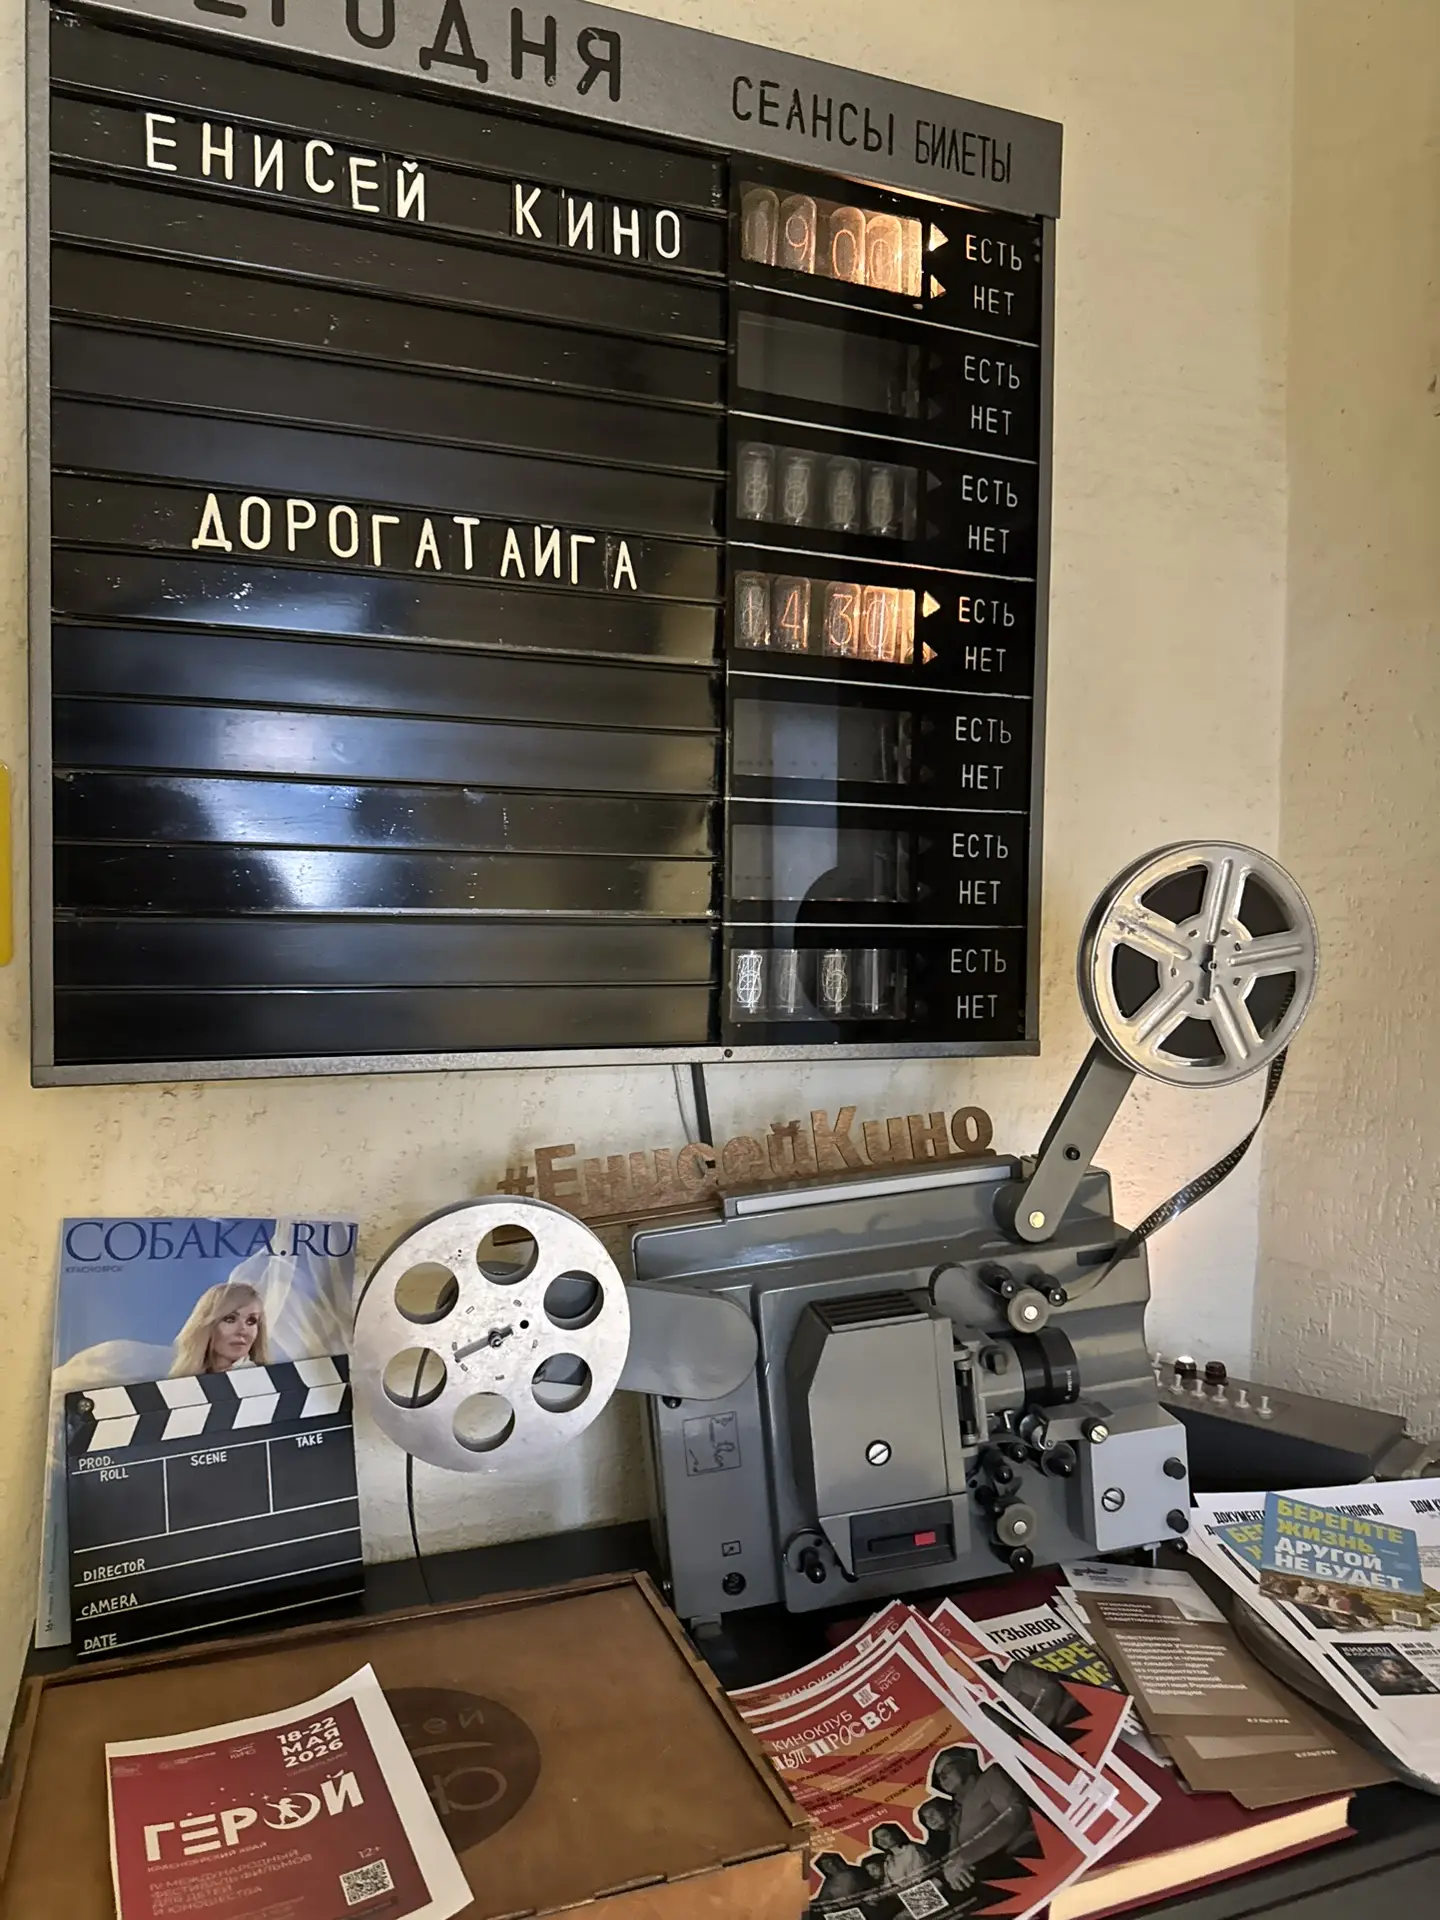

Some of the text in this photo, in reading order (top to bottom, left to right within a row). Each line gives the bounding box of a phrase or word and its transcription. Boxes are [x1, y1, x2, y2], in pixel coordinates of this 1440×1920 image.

[194, 0, 622, 102] ОДНЯ
[732, 75, 1012, 184] СЕАНСЫ БИЛЕТЫ
[145, 112, 681, 259] ЕНИСЕЙ КИНО
[966, 234, 1021, 270] ЕСТЬ
[974, 285, 1014, 315] НЕТ
[965, 356, 1019, 388] ЕСТЬ
[972, 405, 1011, 434] НЕТ
[962, 475, 1017, 507] ЕСТЬ
[969, 525, 1009, 553] НЕТ
[959, 596, 1014, 626] ЕСТЬ
[966, 646, 1006, 671] НЕТ
[956, 716, 1011, 743] ЕСТЬ
[962, 764, 1003, 789] НЕТ
[953, 833, 1008, 858] ЕСТЬ
[960, 881, 1000, 904] НЕТ
[951, 949, 1006, 972] ЕСТЬ
[958, 995, 997, 1018] НЕТ
[497, 1106, 994, 1207] #ЕнисейКино
[66, 1221, 359, 1261] СОБАКА.RU
[295, 1433, 324, 1448] TAKE
[78, 1456, 115, 1471] PROD.
[190, 1451, 228, 1466] SCENE
[100, 1467, 129, 1482] ROLL
[1213, 1510, 1266, 1524] ДОКУМЕНТ
[1410, 1499, 1435, 1513] ДОМ
[1277, 1499, 1404, 1544] БЕРЕГИТЕ
[1277, 1518, 1375, 1554] ЖИЗНЬ
[1275, 1537, 1382, 1572] ДРУГОЙ
[83, 1558, 146, 1582] DIRECTOR
[1275, 1552, 1311, 1572] НЕ
[1315, 1561, 1404, 1590] БУДЕТ
[81, 1593, 139, 1617] CAMERA
[83, 1633, 118, 1650] DATE
[276, 1716, 337, 1745] 18-22
[281, 1729, 341, 1757] МАЯ
[772, 1710, 853, 1752] КИНОКЛУБ
[284, 1741, 344, 1768] 2026
[143, 1769, 364, 1862] ГЕРОЙ
[357, 1846, 381, 1859] 12+
